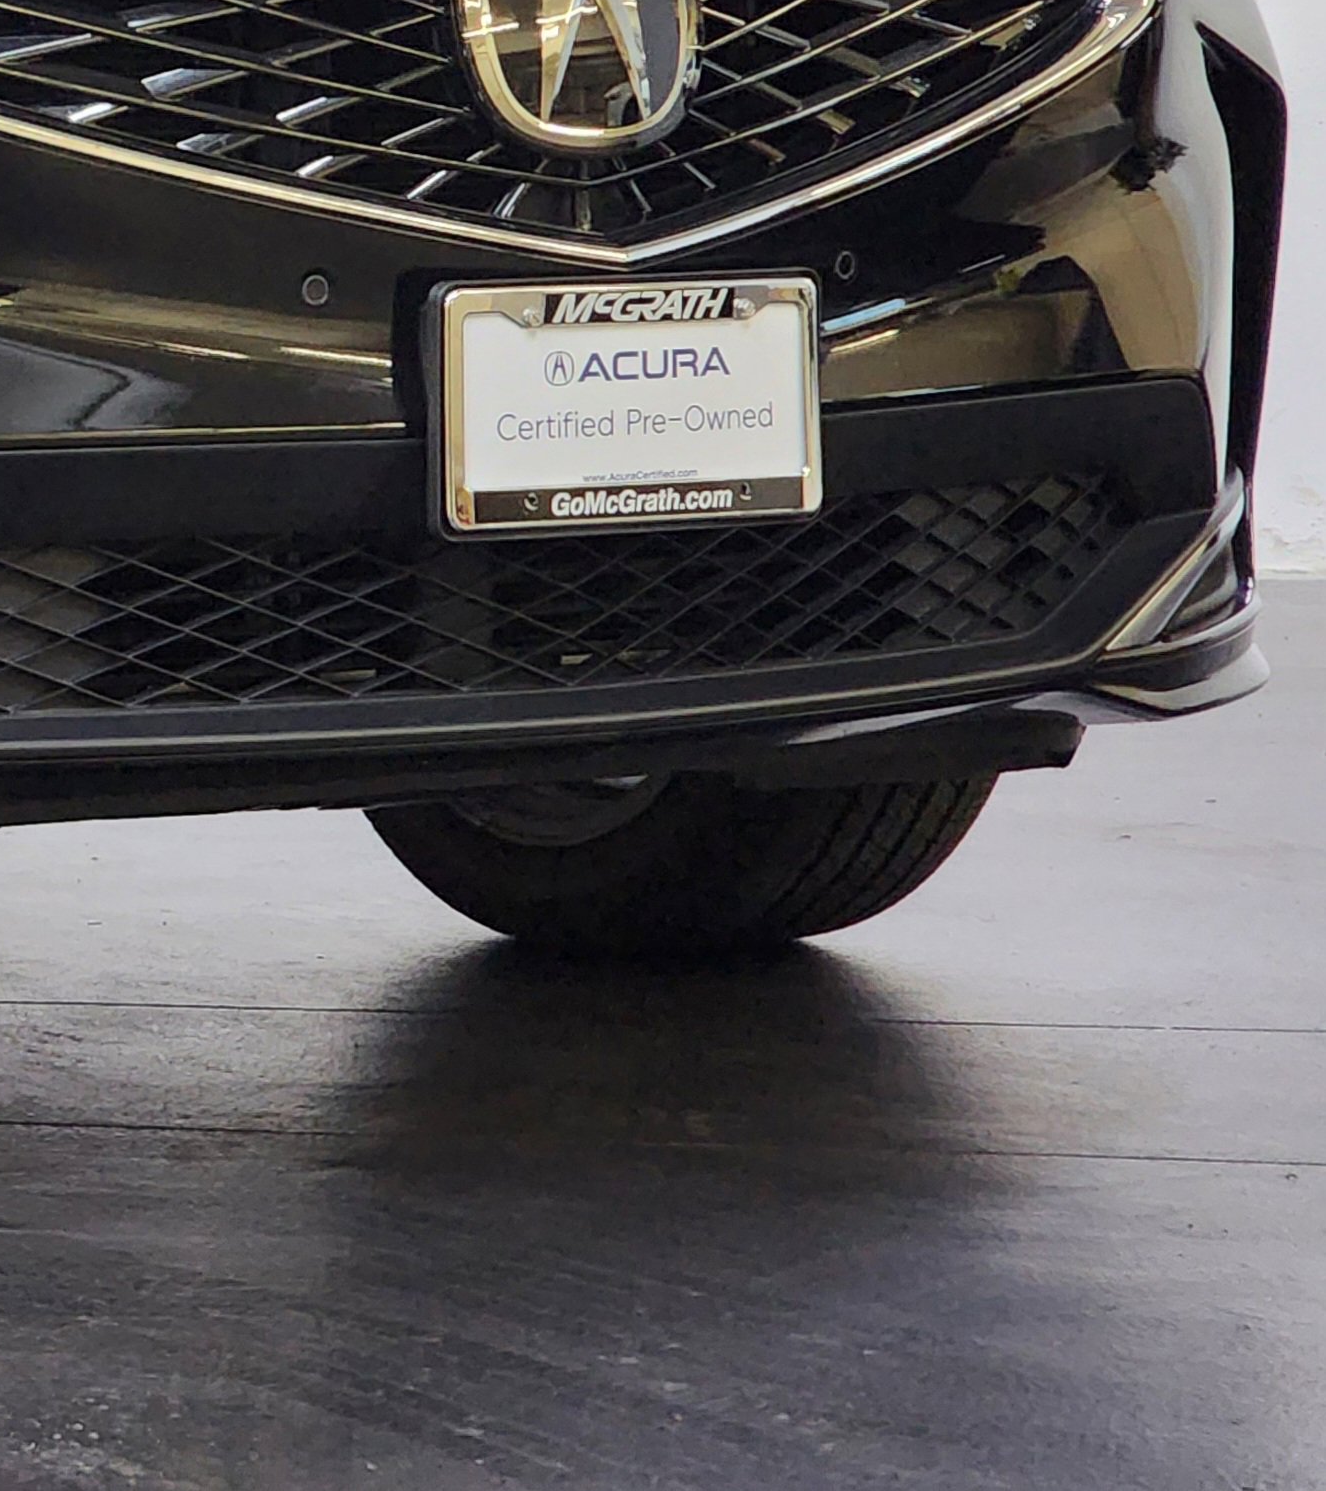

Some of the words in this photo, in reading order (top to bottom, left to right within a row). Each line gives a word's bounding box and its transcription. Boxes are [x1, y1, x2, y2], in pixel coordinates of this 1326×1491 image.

[577, 346, 731, 383] ACURA
[496, 410, 615, 442] Certified
[626, 401, 774, 437] Pre-Owned
[550, 486, 734, 518] GoMcGrath.com
